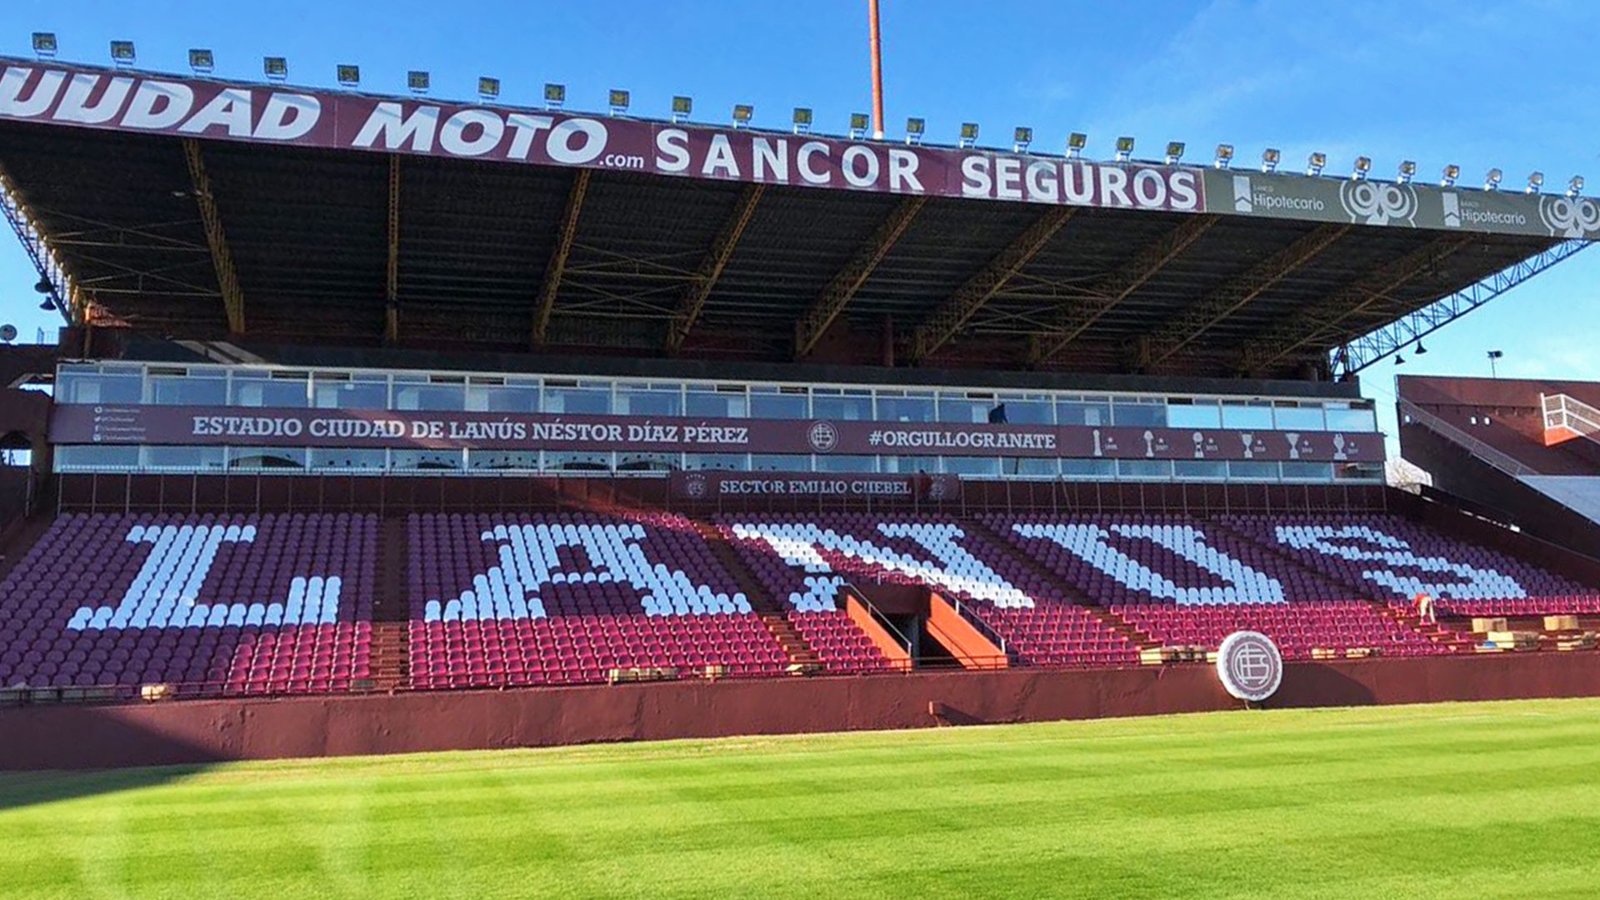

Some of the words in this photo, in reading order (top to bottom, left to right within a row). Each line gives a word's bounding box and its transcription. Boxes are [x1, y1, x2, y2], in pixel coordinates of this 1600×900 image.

[654, 128, 925, 193] SANCOR
[961, 155, 1198, 212] SEGUROS
[1253, 193, 1325, 212] Hipotecario
[1460, 209, 1527, 226] Hipotecario
[193, 415, 304, 436] ESTADIO
[308, 418, 406, 439] CIUDAD
[411, 420, 445, 439] DE
[448, 416, 527, 441] LANÚS
[532, 417, 622, 442] NÉSTOR
[627, 420, 678, 443] DÍAZ
[682, 420, 749, 444] PÉREZ
[868, 430, 1057, 450] #ORGULLOGRANATE
[719, 479, 786, 494] SECTOR
[788, 480, 847, 494] EMILIO
